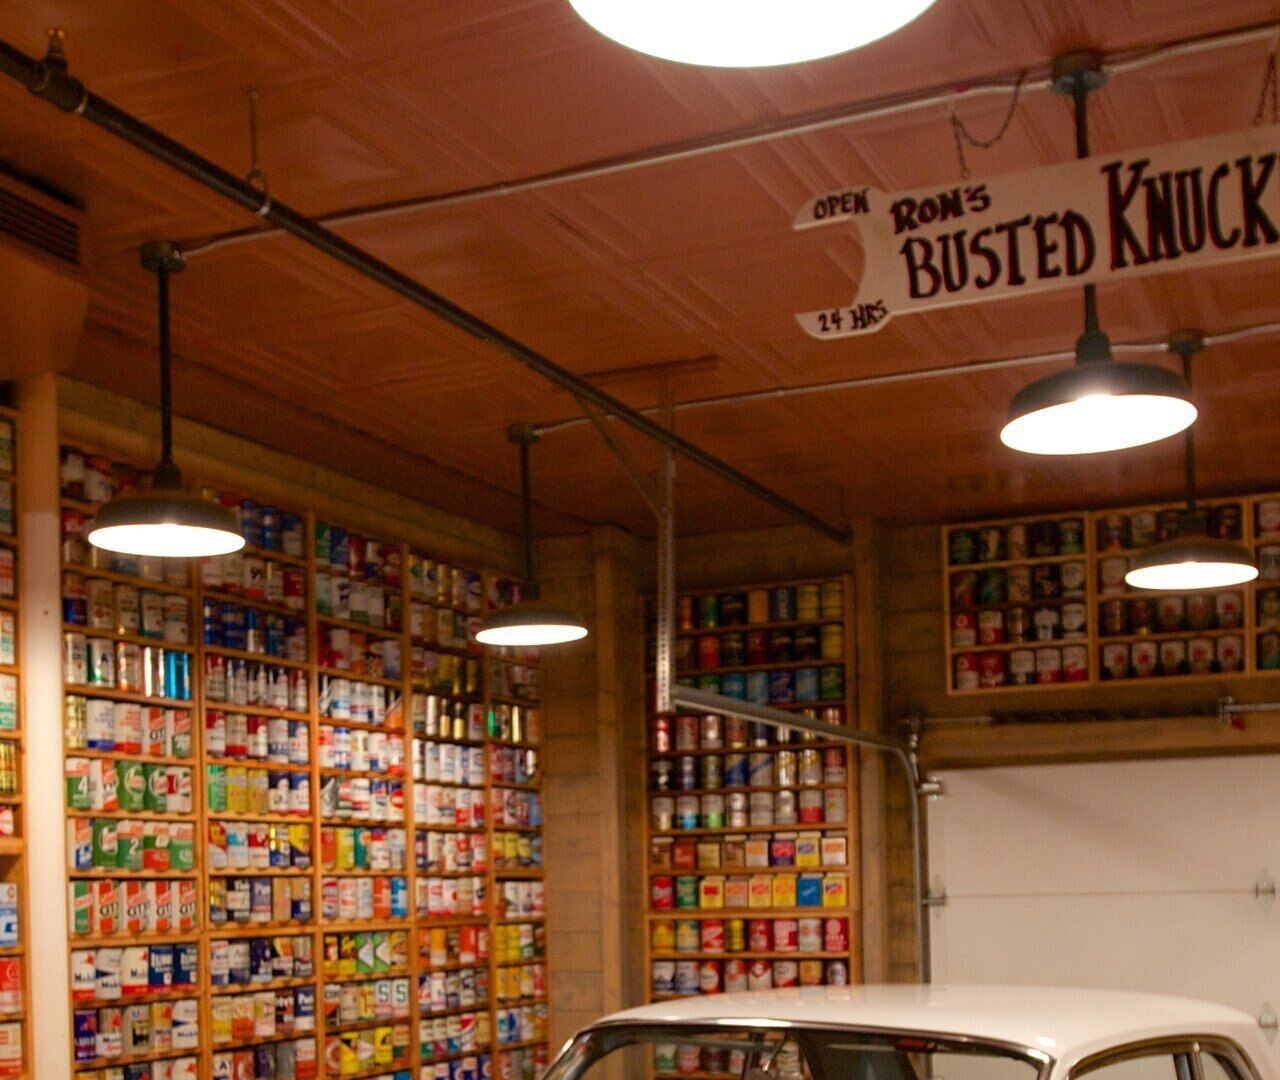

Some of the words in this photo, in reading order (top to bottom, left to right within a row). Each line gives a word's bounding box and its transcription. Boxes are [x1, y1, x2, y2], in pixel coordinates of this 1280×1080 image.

[812, 187, 871, 220] OPEN
[891, 185, 992, 235] RON'S
[900, 208, 1097, 300] BUSTED
[816, 309, 846, 332] 24
[848, 302, 890, 332] HRS
